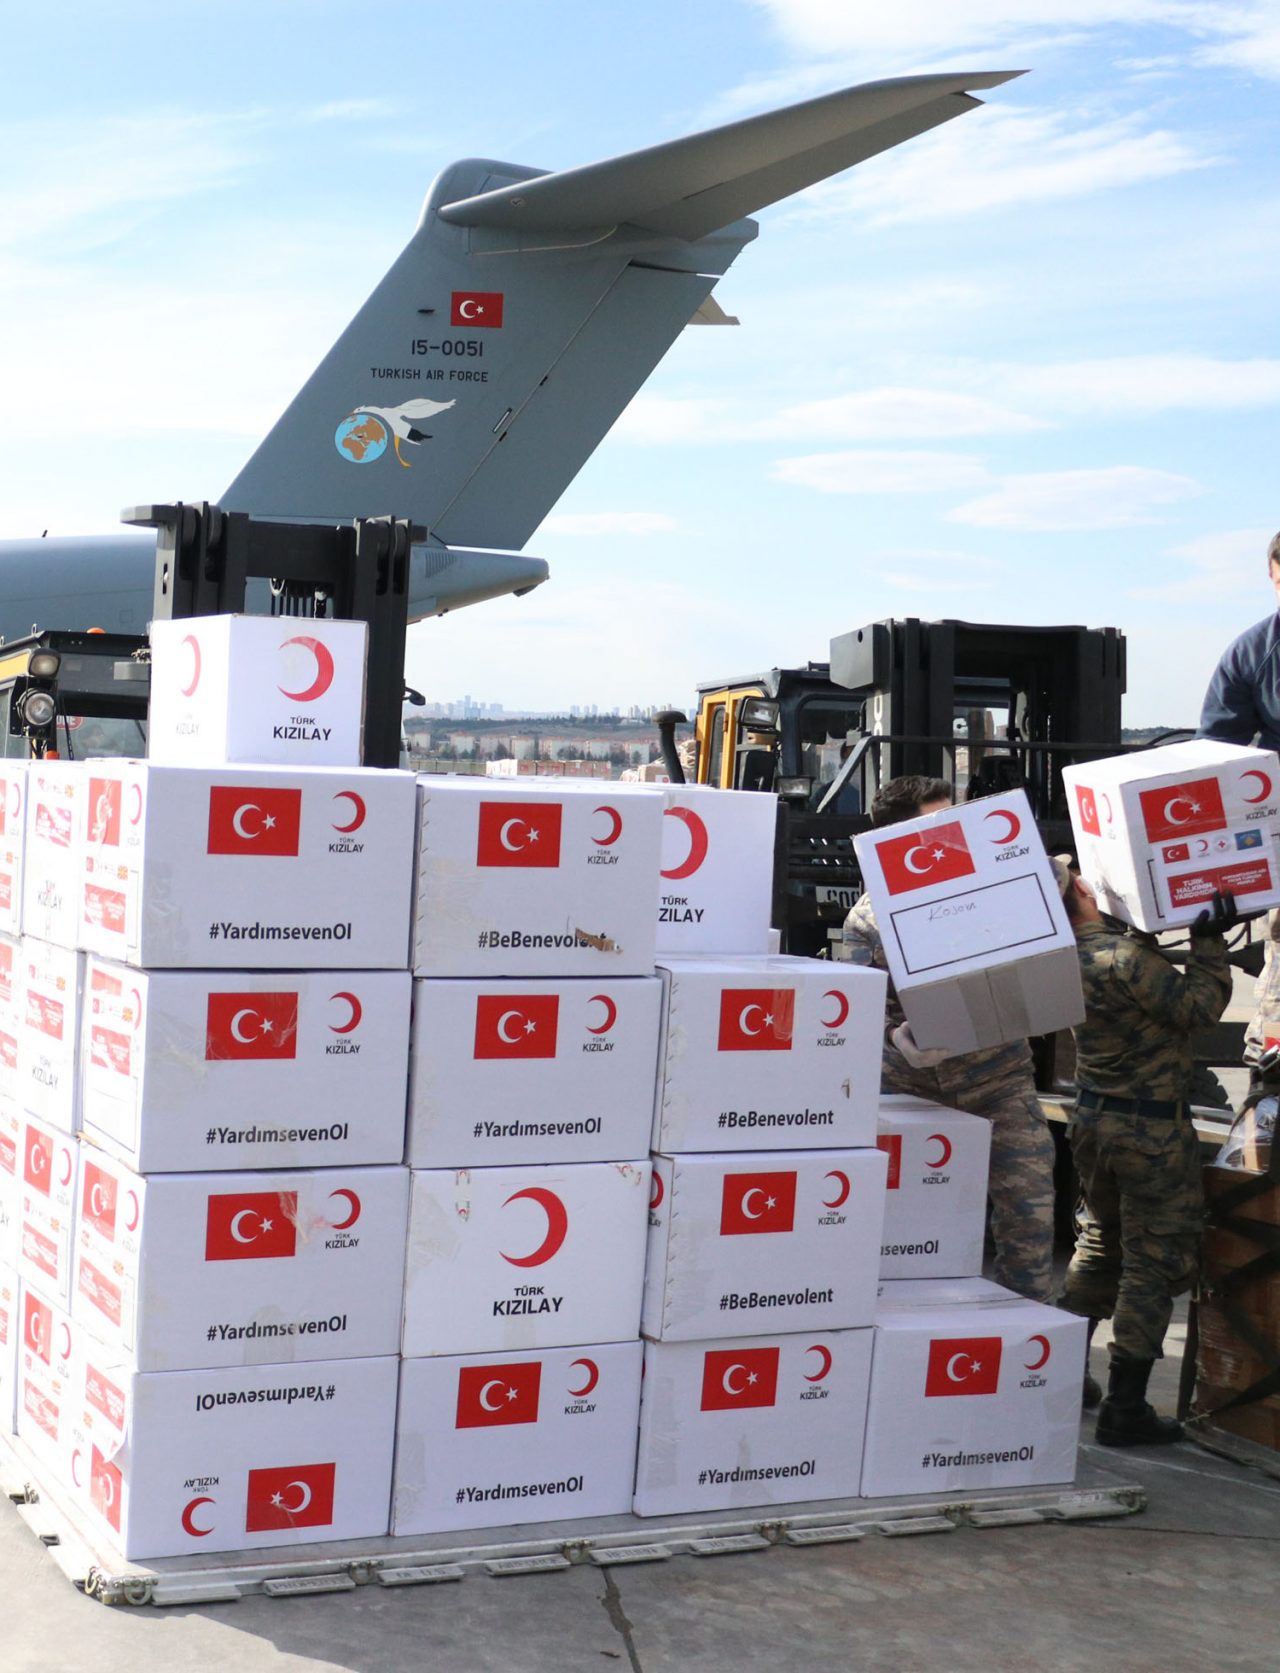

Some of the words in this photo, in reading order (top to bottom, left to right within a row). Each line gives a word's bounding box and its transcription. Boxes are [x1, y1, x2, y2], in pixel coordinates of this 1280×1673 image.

[412, 340, 482, 357] 15-0051
[371, 368, 420, 379] TURKISH
[426, 370, 444, 380] AIR
[450, 370, 488, 382] FORCE
[290, 715, 316, 725] TÜRK
[273, 725, 332, 741] KIZILAY
[1246, 810, 1277, 821] KIZILAY
[328, 842, 364, 854] KIZILAY
[995, 847, 1030, 862] KIZILAY
[587, 855, 619, 865] KIZILAY
[661, 896, 688, 905] TÜRK
[658, 908, 704, 922] ZILAY
[209, 921, 352, 943] #YardımsevenOl
[582, 1043, 615, 1053] KIZILAY
[816, 1037, 846, 1047] KIZILAY
[325, 1044, 361, 1055] KIZILAY
[32, 1064, 58, 1089] KIZILAY
[717, 1109, 834, 1129] #BeBenevolent
[473, 1117, 602, 1138] #YardımsevenOl
[923, 1177, 950, 1185] KIZILAY
[818, 1216, 847, 1226] KIZILAY
[325, 1238, 359, 1249] KIZILAY
[881, 1240, 939, 1255] sevenOl
[513, 1284, 544, 1297] TÜRK
[719, 1288, 833, 1311] #BeBenevolent
[492, 1297, 563, 1316] KIZILAY
[1020, 1379, 1047, 1389] KIZILAY
[799, 1390, 829, 1400] KIZILAY
[564, 1404, 596, 1414] KIZILAY
[922, 1447, 1034, 1469] #YardımsevenOl
[698, 1460, 815, 1486] #YardımsevenOl
[183, 1476, 220, 1488] KIZILAY
[456, 1475, 583, 1503] #YardımsevenOl
